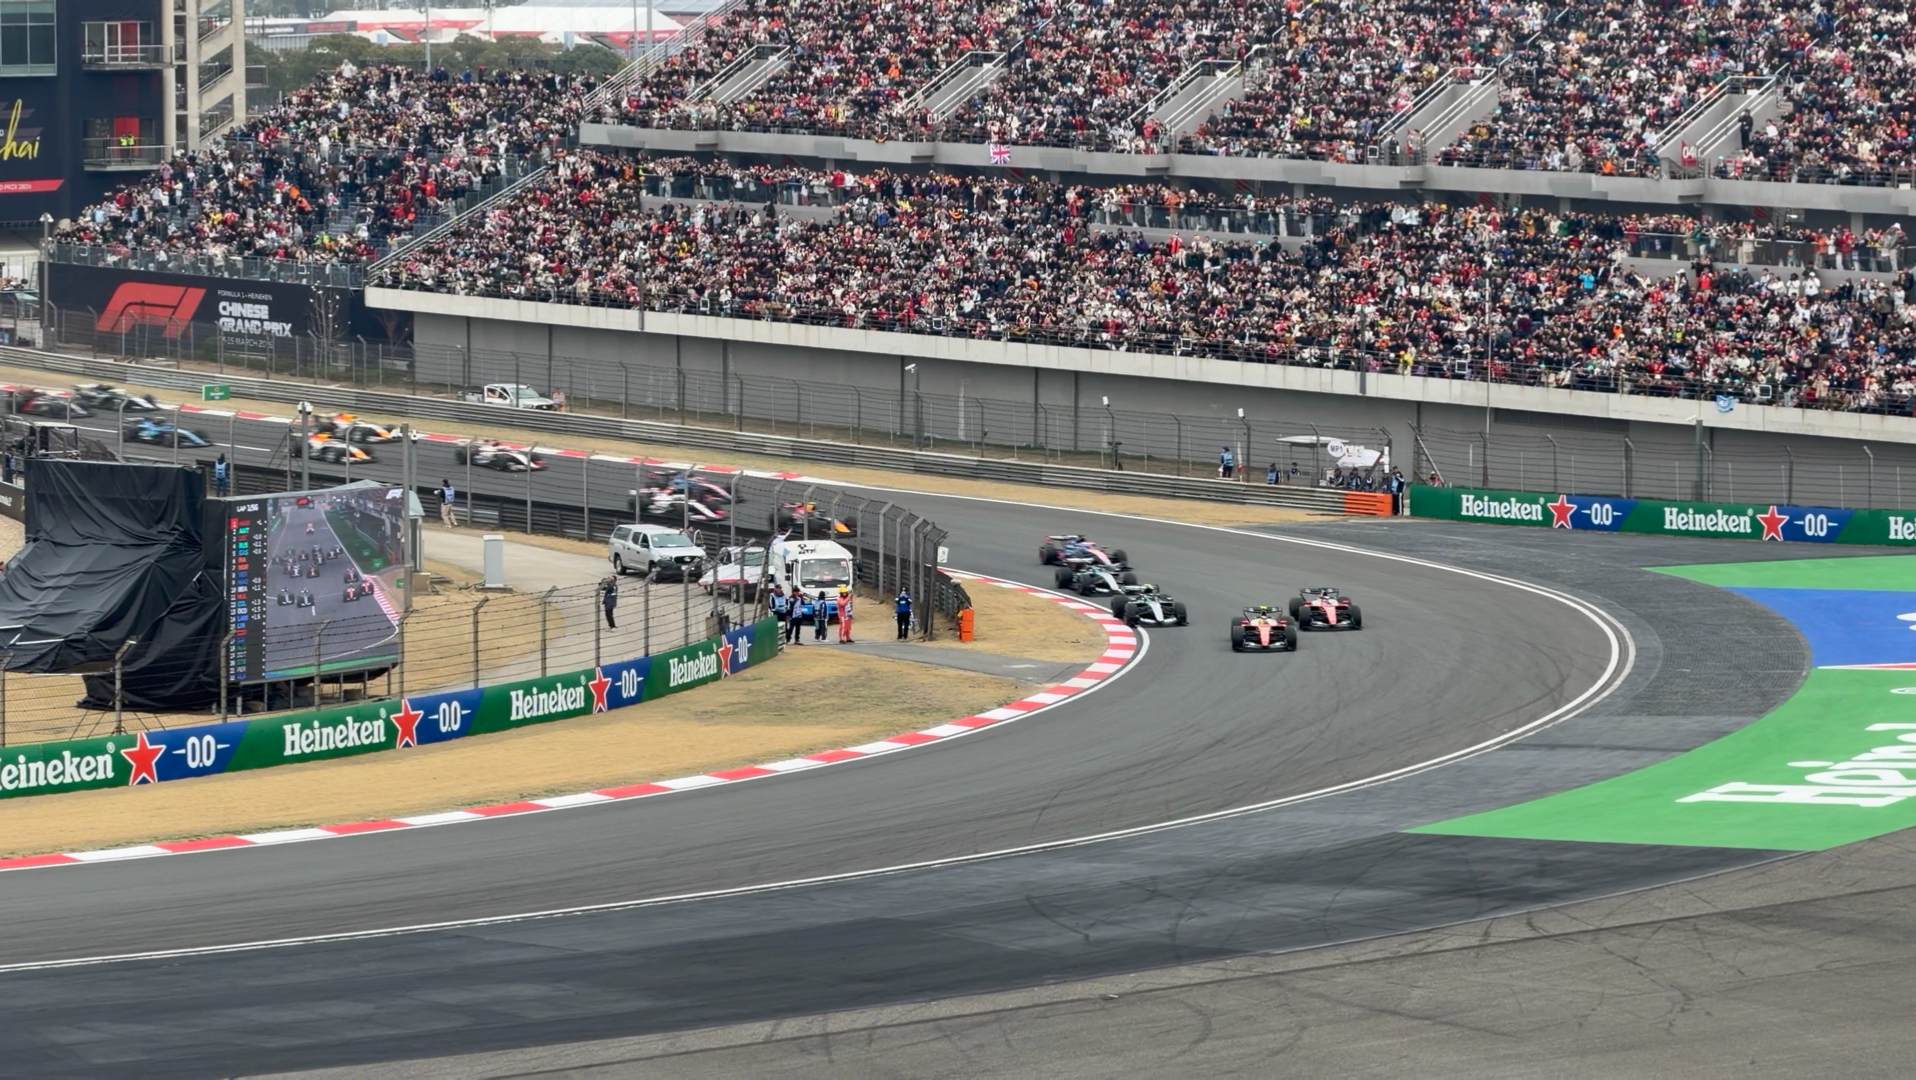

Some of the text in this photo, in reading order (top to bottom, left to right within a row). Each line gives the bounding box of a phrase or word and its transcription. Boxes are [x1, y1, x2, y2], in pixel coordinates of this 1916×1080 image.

[218, 290, 240, 298] FORMULA
[218, 301, 269, 319] CHINESE
[219, 317, 292, 337] GRAND PRIX
[1461, 494, 1543, 520] Heineken
[1664, 507, 1752, 533] Heineken
[1888, 516, 1916, 540] He
[669, 651, 717, 687] Heineken
[510, 683, 585, 721] Heineken
[283, 716, 386, 756] Heineken
[0, 751, 114, 790] eineken
